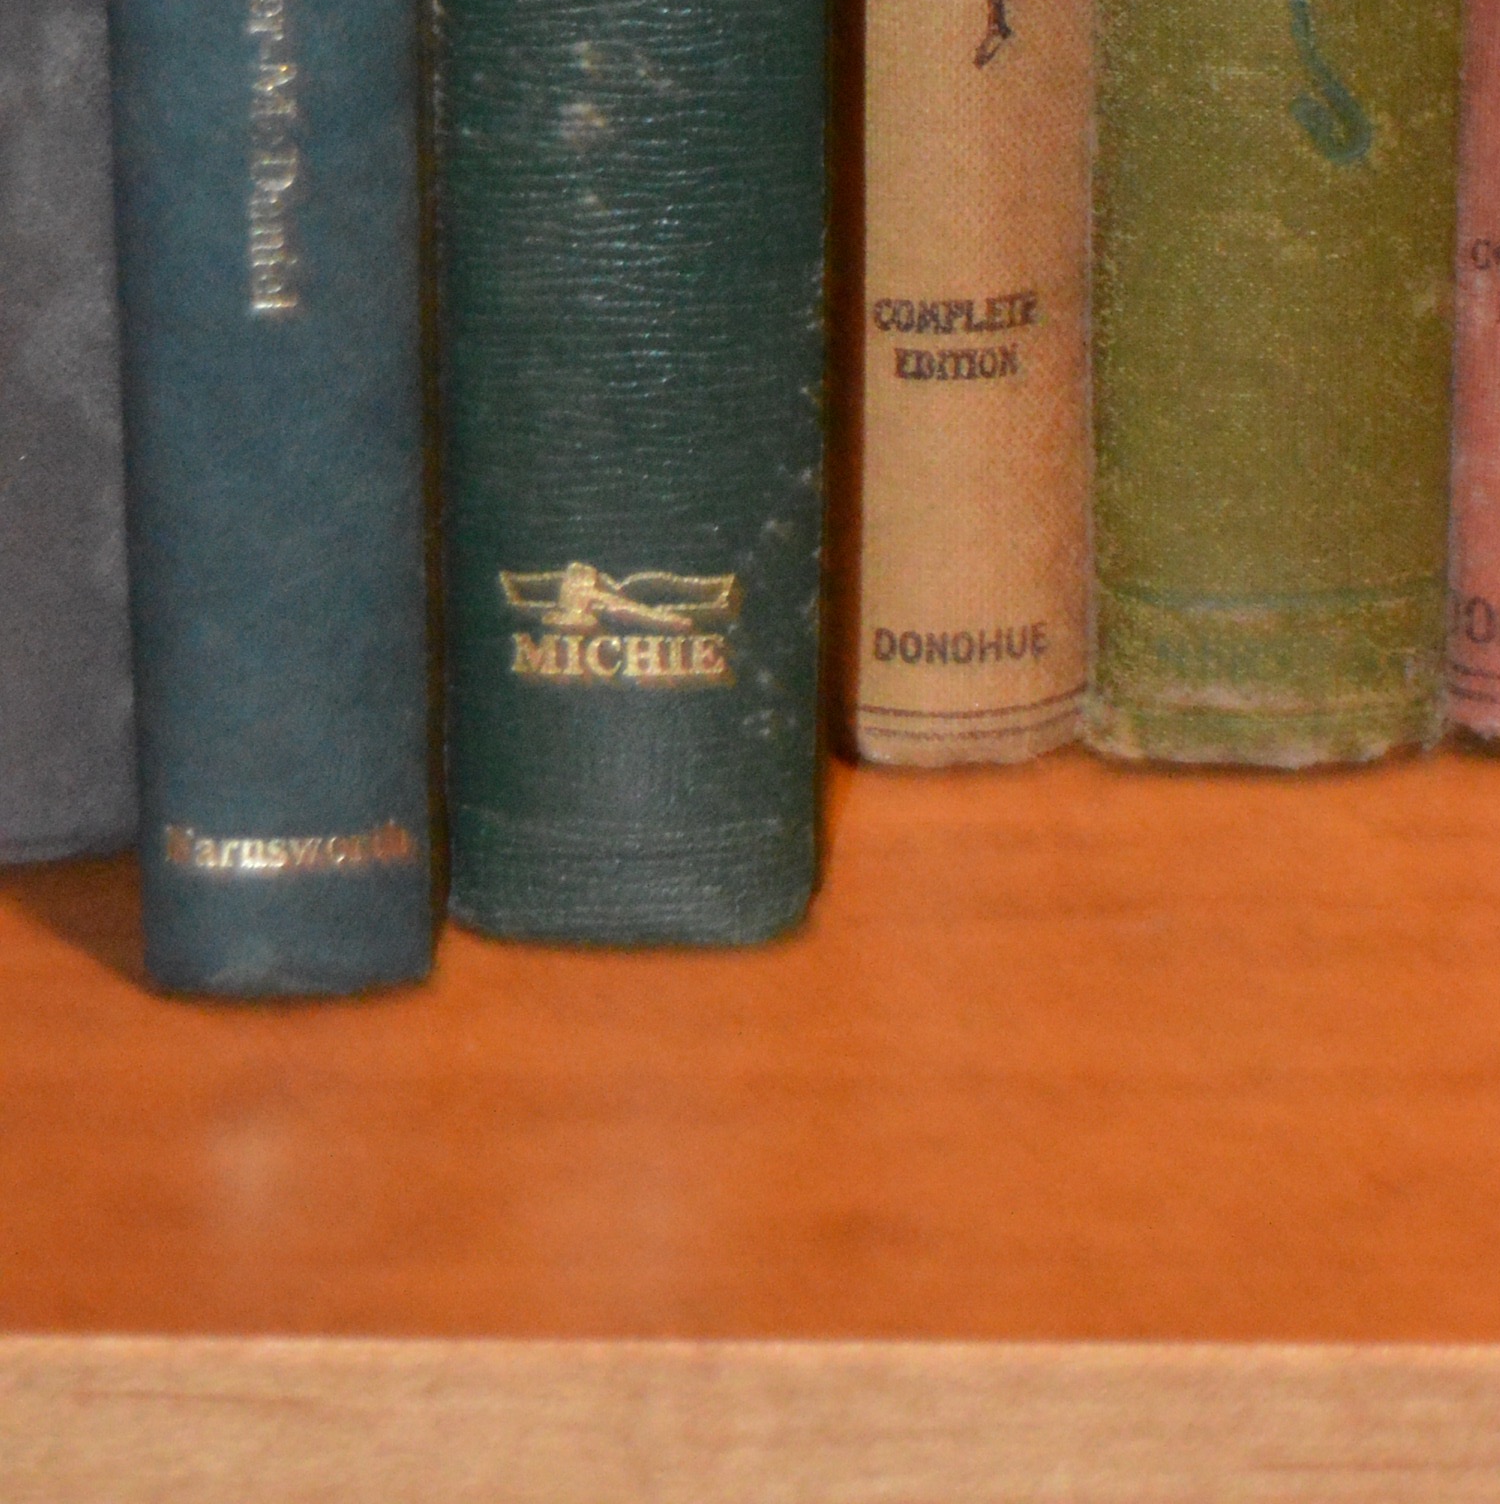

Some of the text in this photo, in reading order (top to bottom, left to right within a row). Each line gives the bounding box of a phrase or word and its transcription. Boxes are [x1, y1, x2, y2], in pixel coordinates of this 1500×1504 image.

[872, 291, 1039, 335] COMPLETE
[893, 342, 1022, 381] EDITION
[511, 632, 727, 678] MICHIE
[872, 621, 1049, 665] DONOHUE
